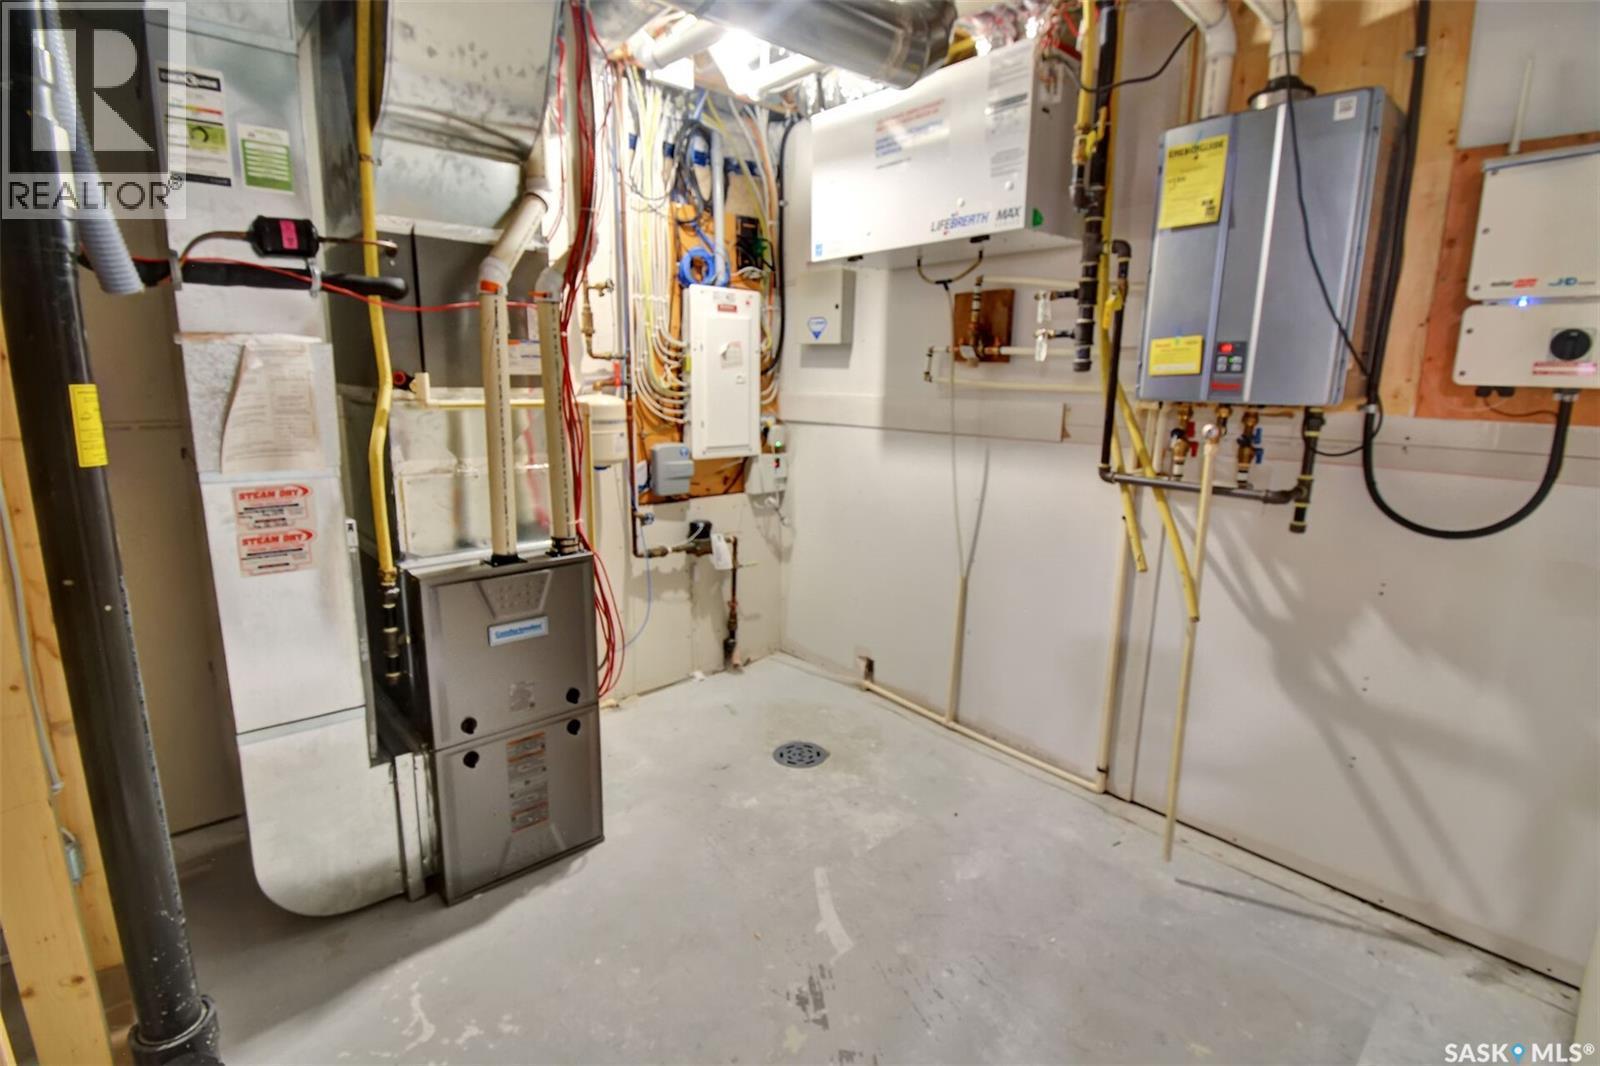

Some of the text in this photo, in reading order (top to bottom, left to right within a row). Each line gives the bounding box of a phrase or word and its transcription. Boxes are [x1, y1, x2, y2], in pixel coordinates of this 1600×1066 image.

[996, 206, 1022, 220] MAX
[239, 489, 298, 501] STEAM DRY
[242, 533, 302, 546] STEAM DRY
